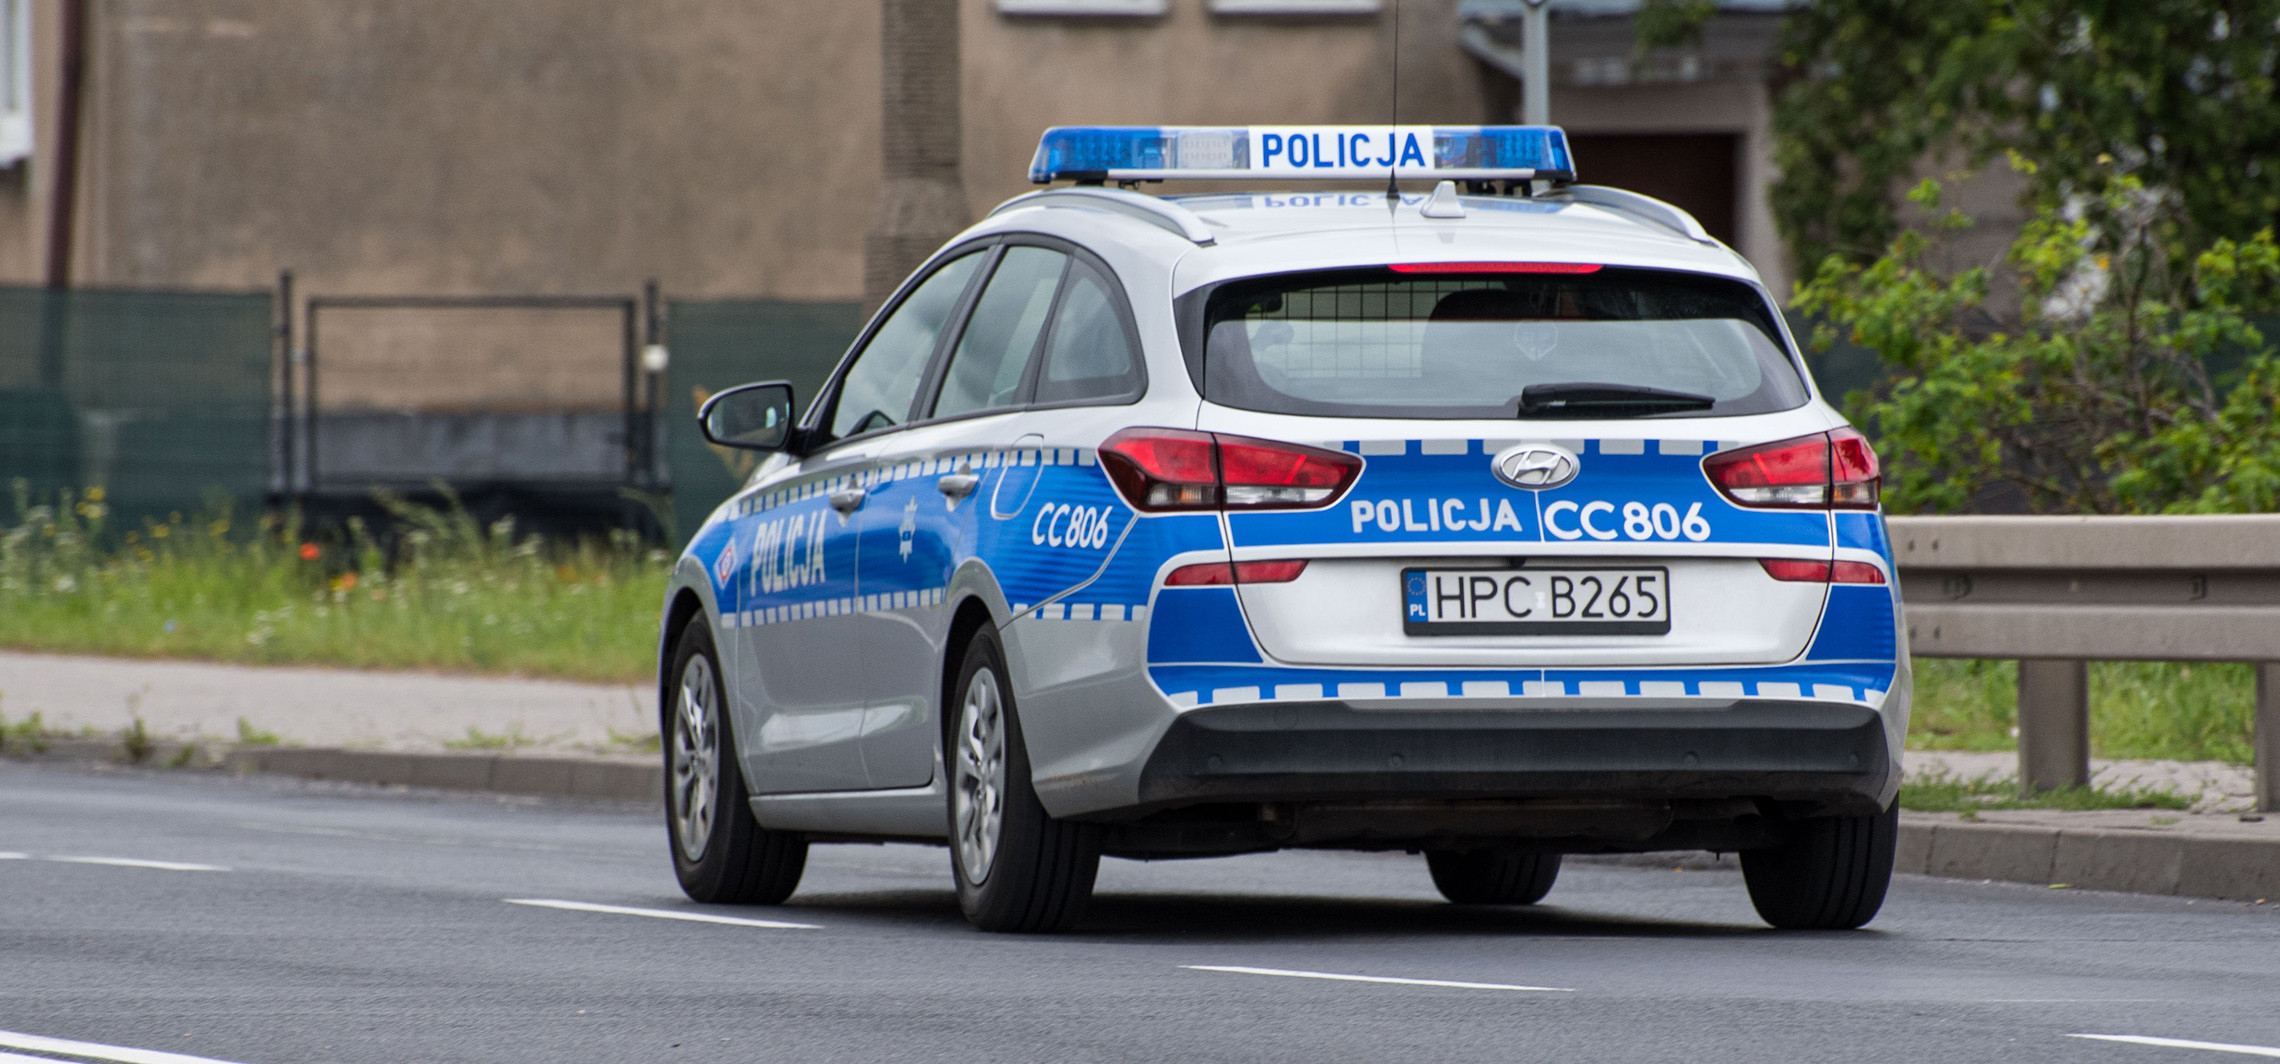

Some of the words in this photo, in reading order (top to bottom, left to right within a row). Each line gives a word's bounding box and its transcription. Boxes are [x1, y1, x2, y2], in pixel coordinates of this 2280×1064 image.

[1262, 133, 1426, 168] POLICJA
[1032, 501, 1113, 549] CC806
[1351, 498, 1523, 534] POLICJA
[1544, 501, 1711, 541] CC806
[751, 509, 826, 597] POLICJA
[1409, 604, 1427, 616] PL
[1435, 576, 1533, 619] HPC
[1551, 575, 1659, 619] B265
